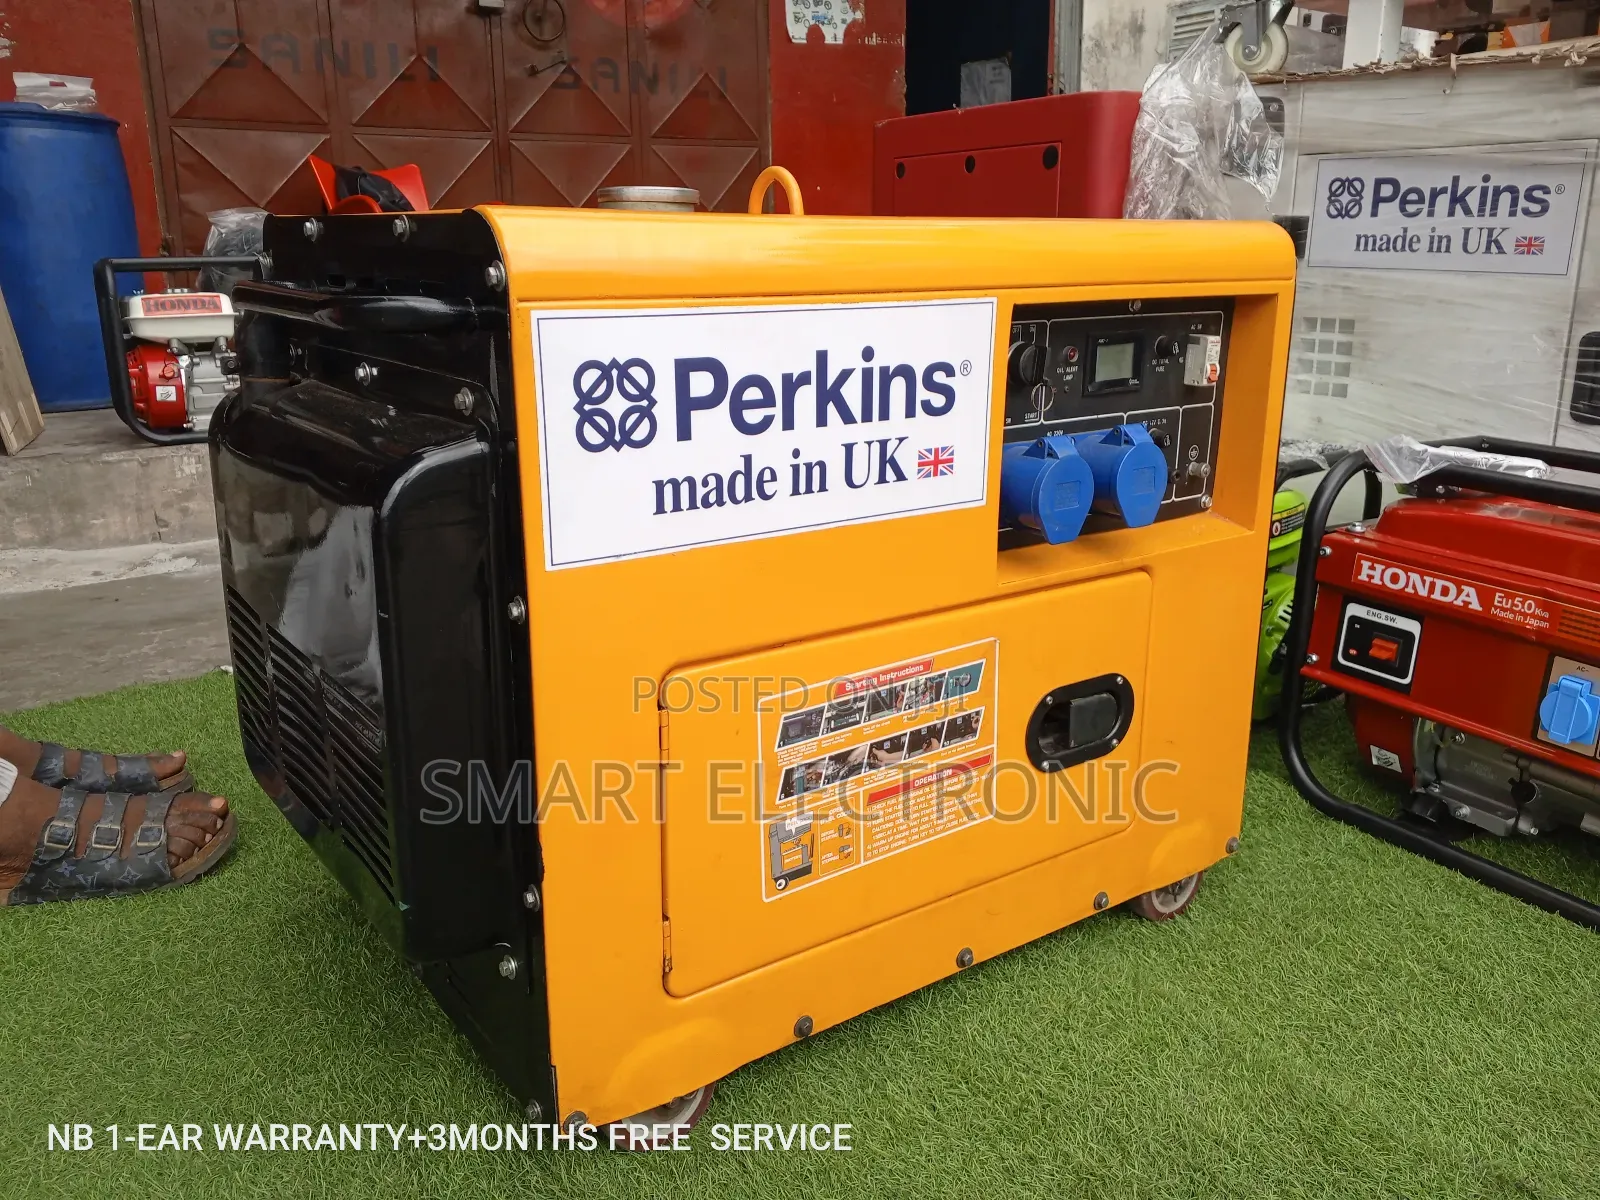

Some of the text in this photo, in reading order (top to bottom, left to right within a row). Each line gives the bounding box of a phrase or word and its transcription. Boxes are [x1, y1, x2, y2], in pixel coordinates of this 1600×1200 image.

[1370, 174, 1551, 218] Perkins
[1354, 226, 1510, 255] made in UK
[144, 297, 220, 312] HONDA
[674, 345, 956, 442] Perkins
[652, 436, 910, 516] made in UK
[1358, 560, 1482, 611] HONDA
[1366, 610, 1398, 624] ENG.SW.
[1490, 606, 1550, 629] Made in Japan
[846, 664, 924, 691] Starting Instructions
[914, 768, 953, 786] OPERATION
